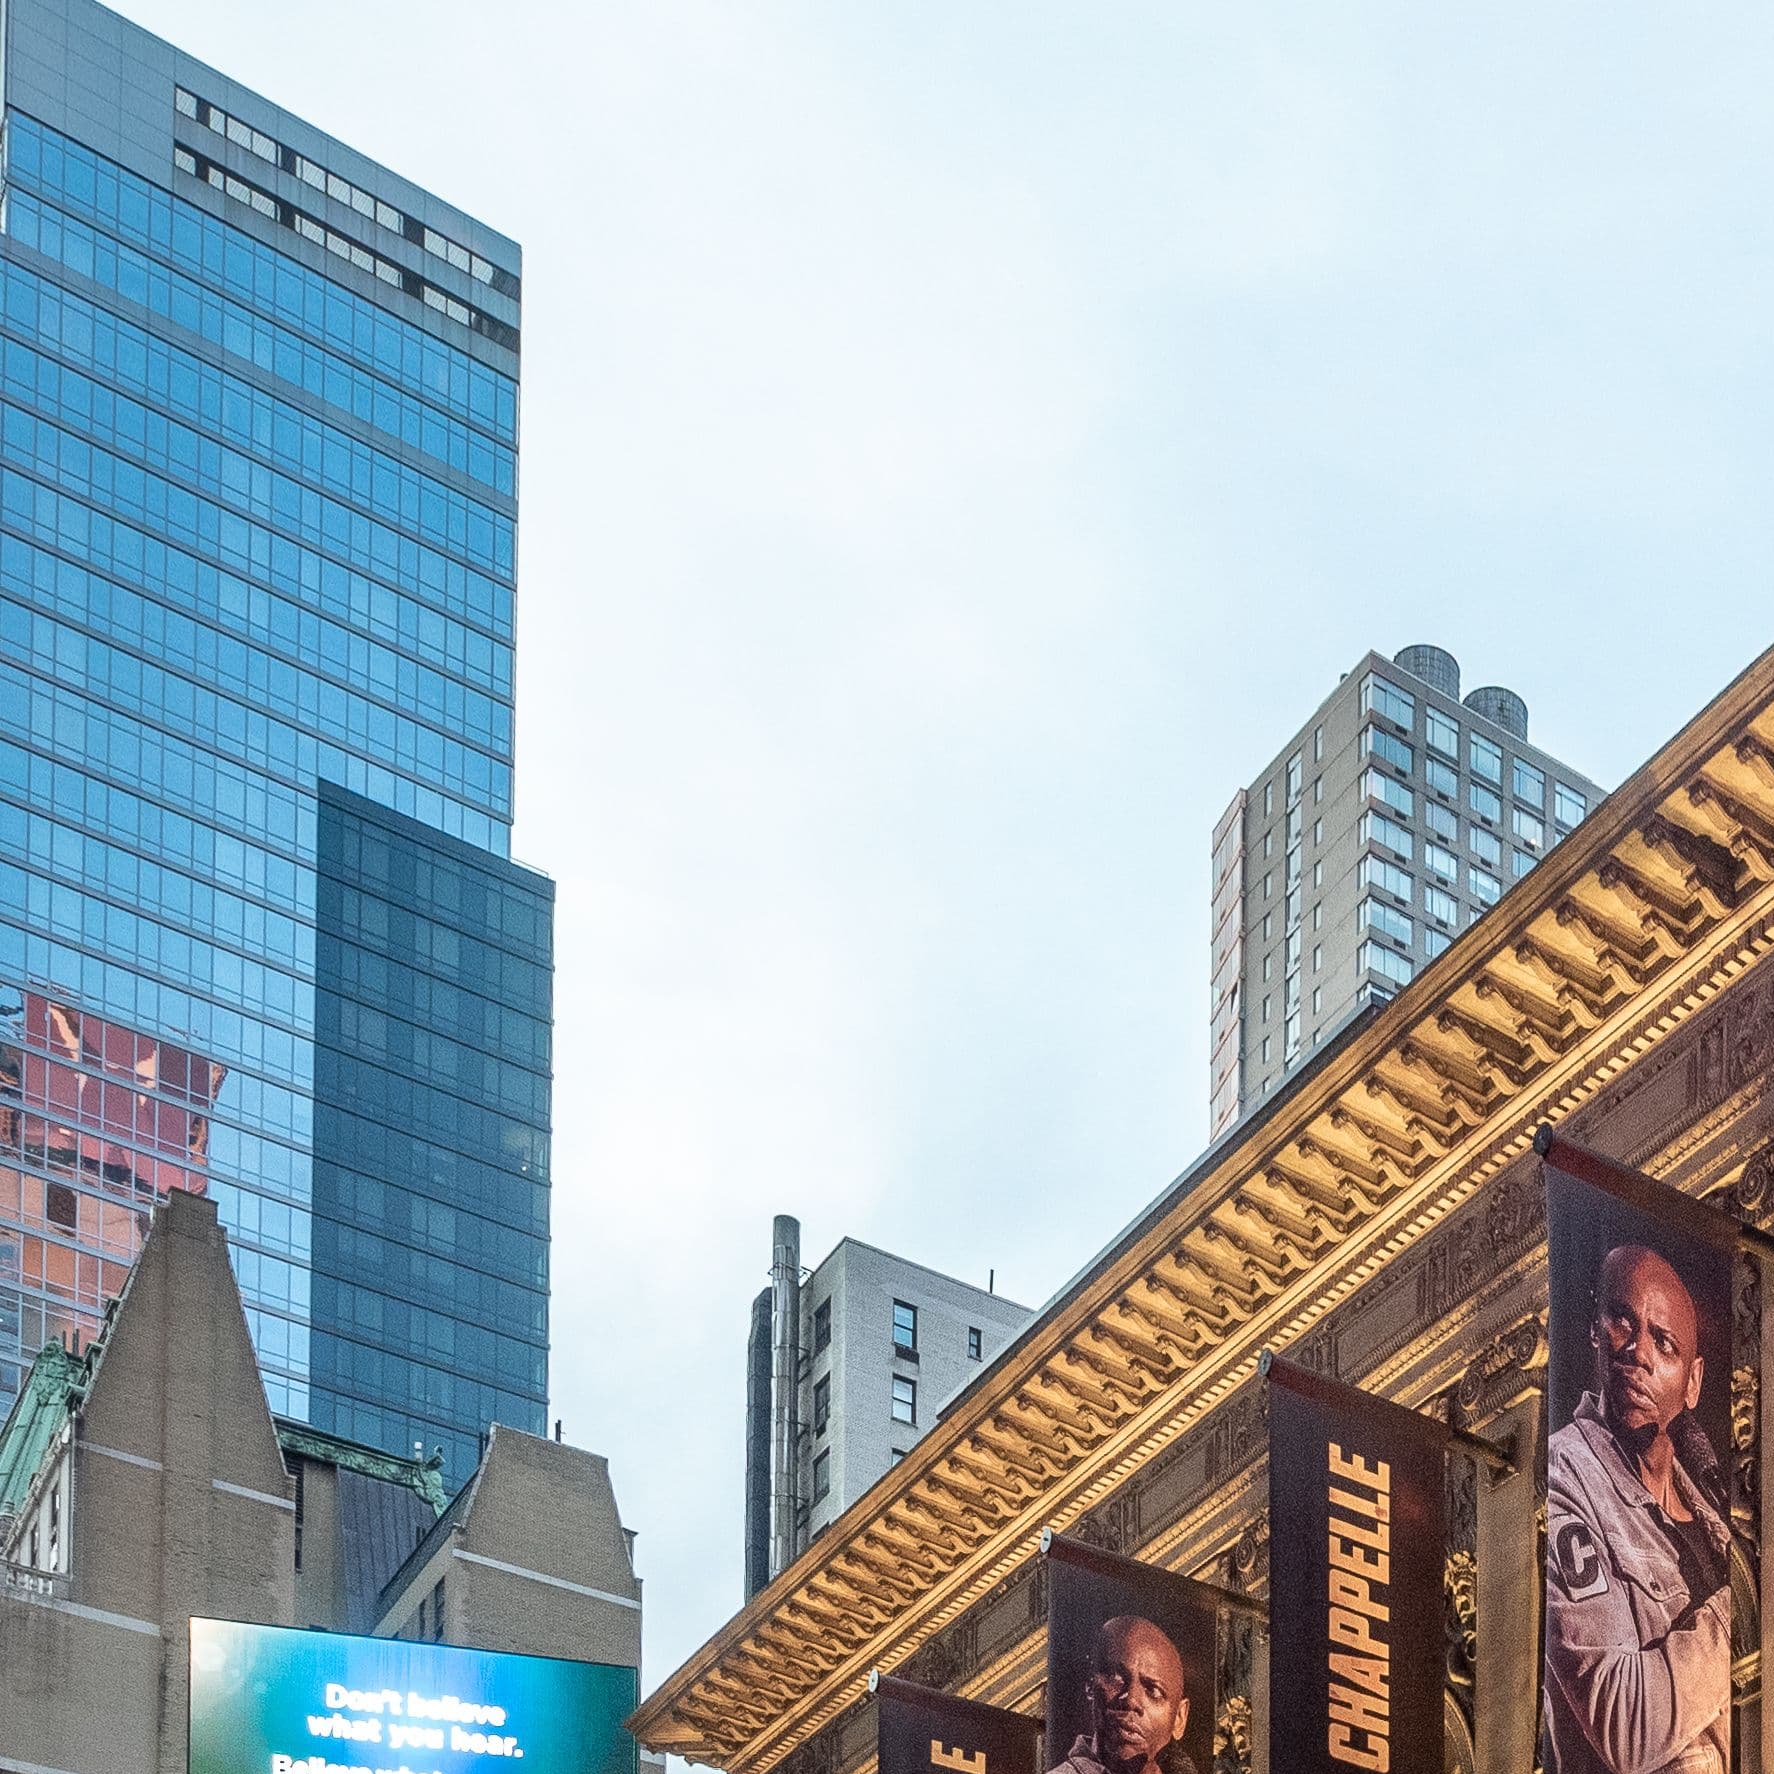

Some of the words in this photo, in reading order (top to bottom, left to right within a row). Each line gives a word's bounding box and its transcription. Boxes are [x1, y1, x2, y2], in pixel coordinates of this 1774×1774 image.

[1329, 1443, 1391, 1773] CHAPPELLE
[325, 1683, 401, 1716] Don't
[407, 1692, 506, 1726] believe
[307, 1713, 382, 1743] what
[388, 1723, 444, 1749] you
[451, 1726, 524, 1758] hear.
